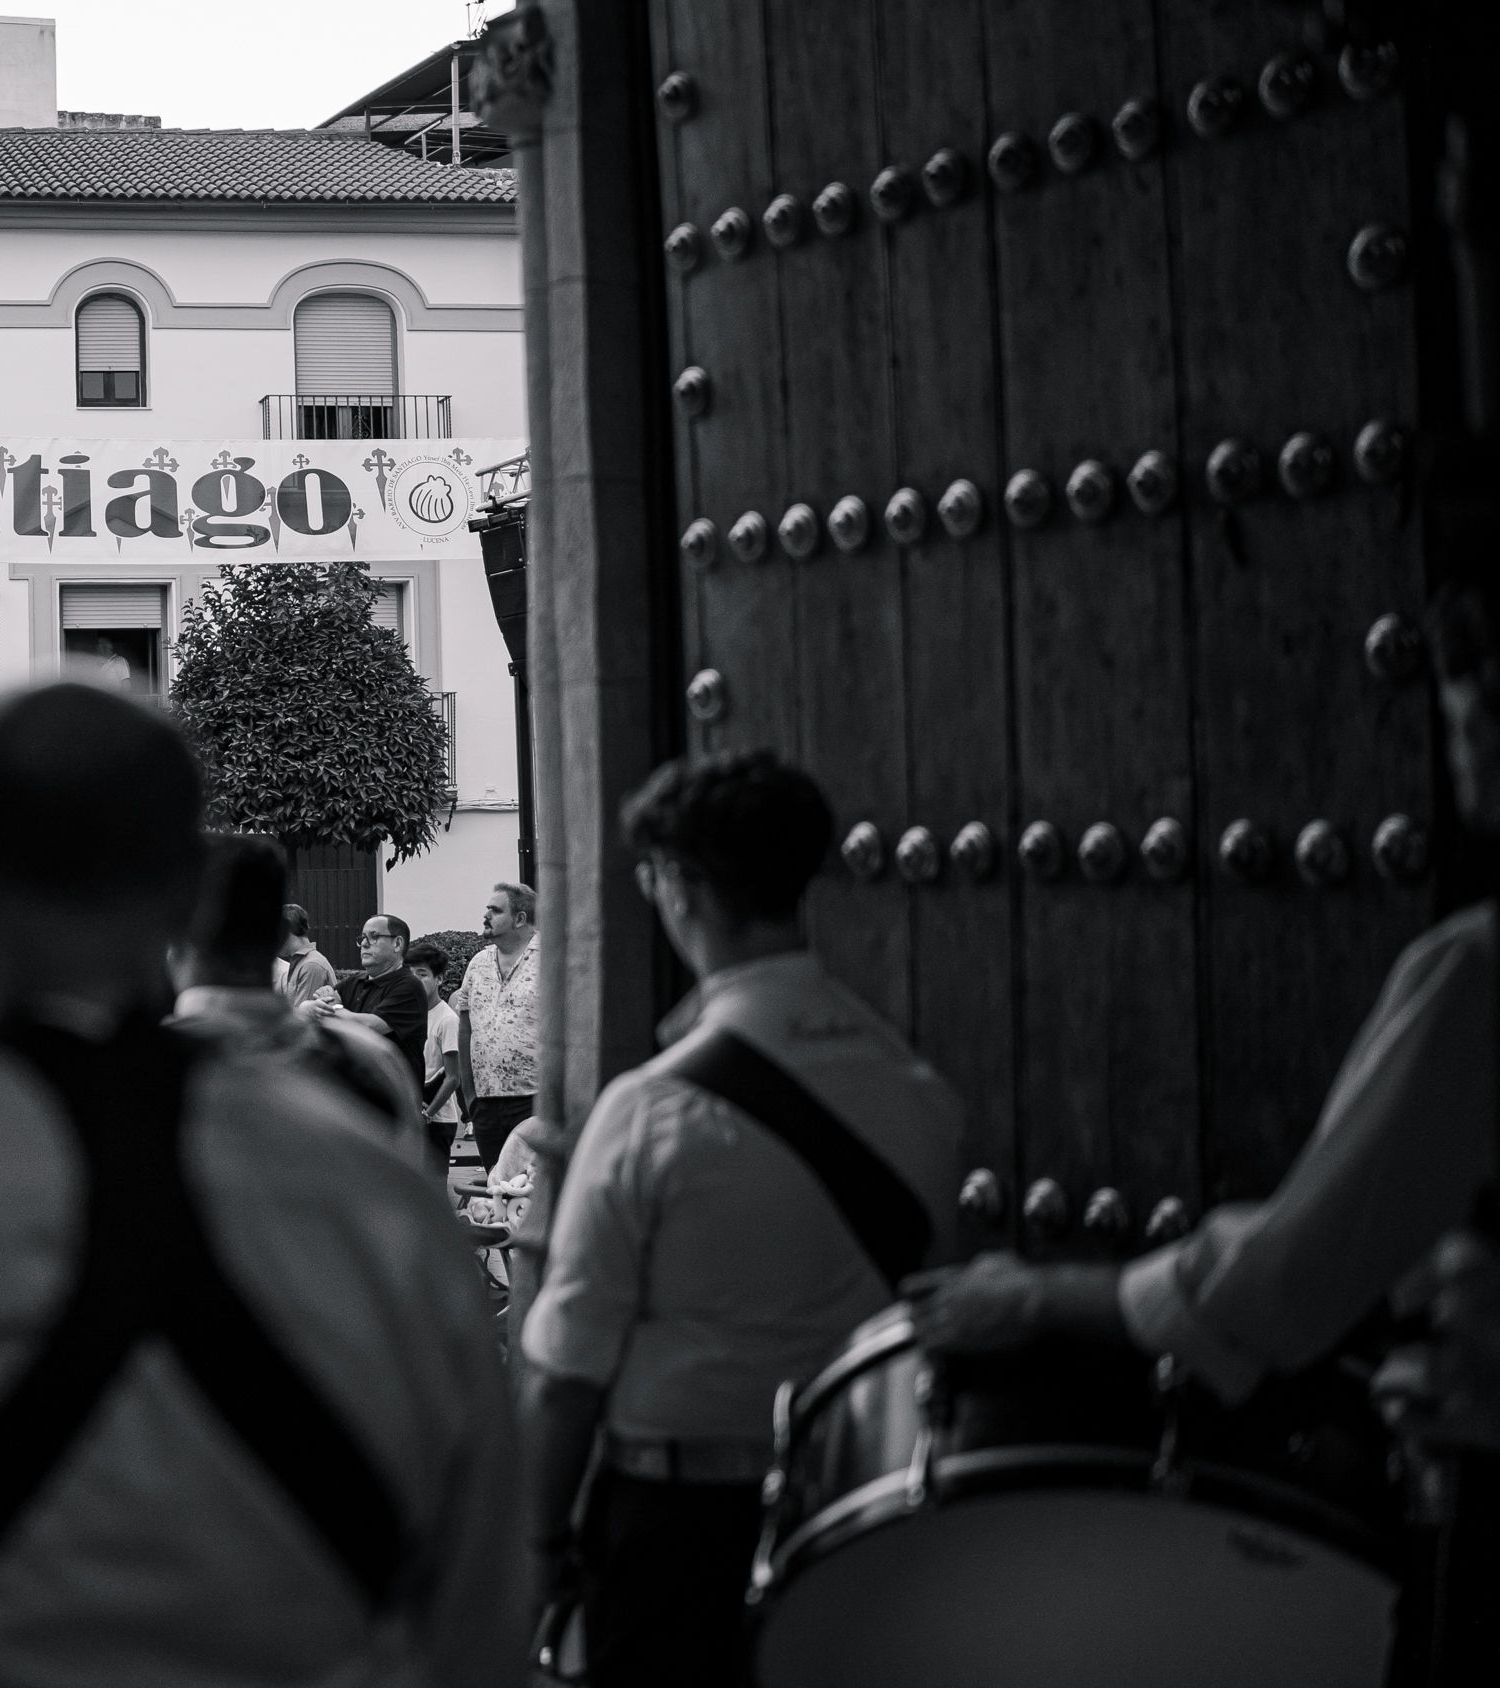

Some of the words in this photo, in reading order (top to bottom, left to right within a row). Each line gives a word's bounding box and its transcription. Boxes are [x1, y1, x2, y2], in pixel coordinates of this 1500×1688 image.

[392, 455, 422, 479] SANTIAGO
[388, 479, 395, 489] DE
[387, 489, 397, 516] BARRIO
[422, 536, 450, 544] LUCENA
